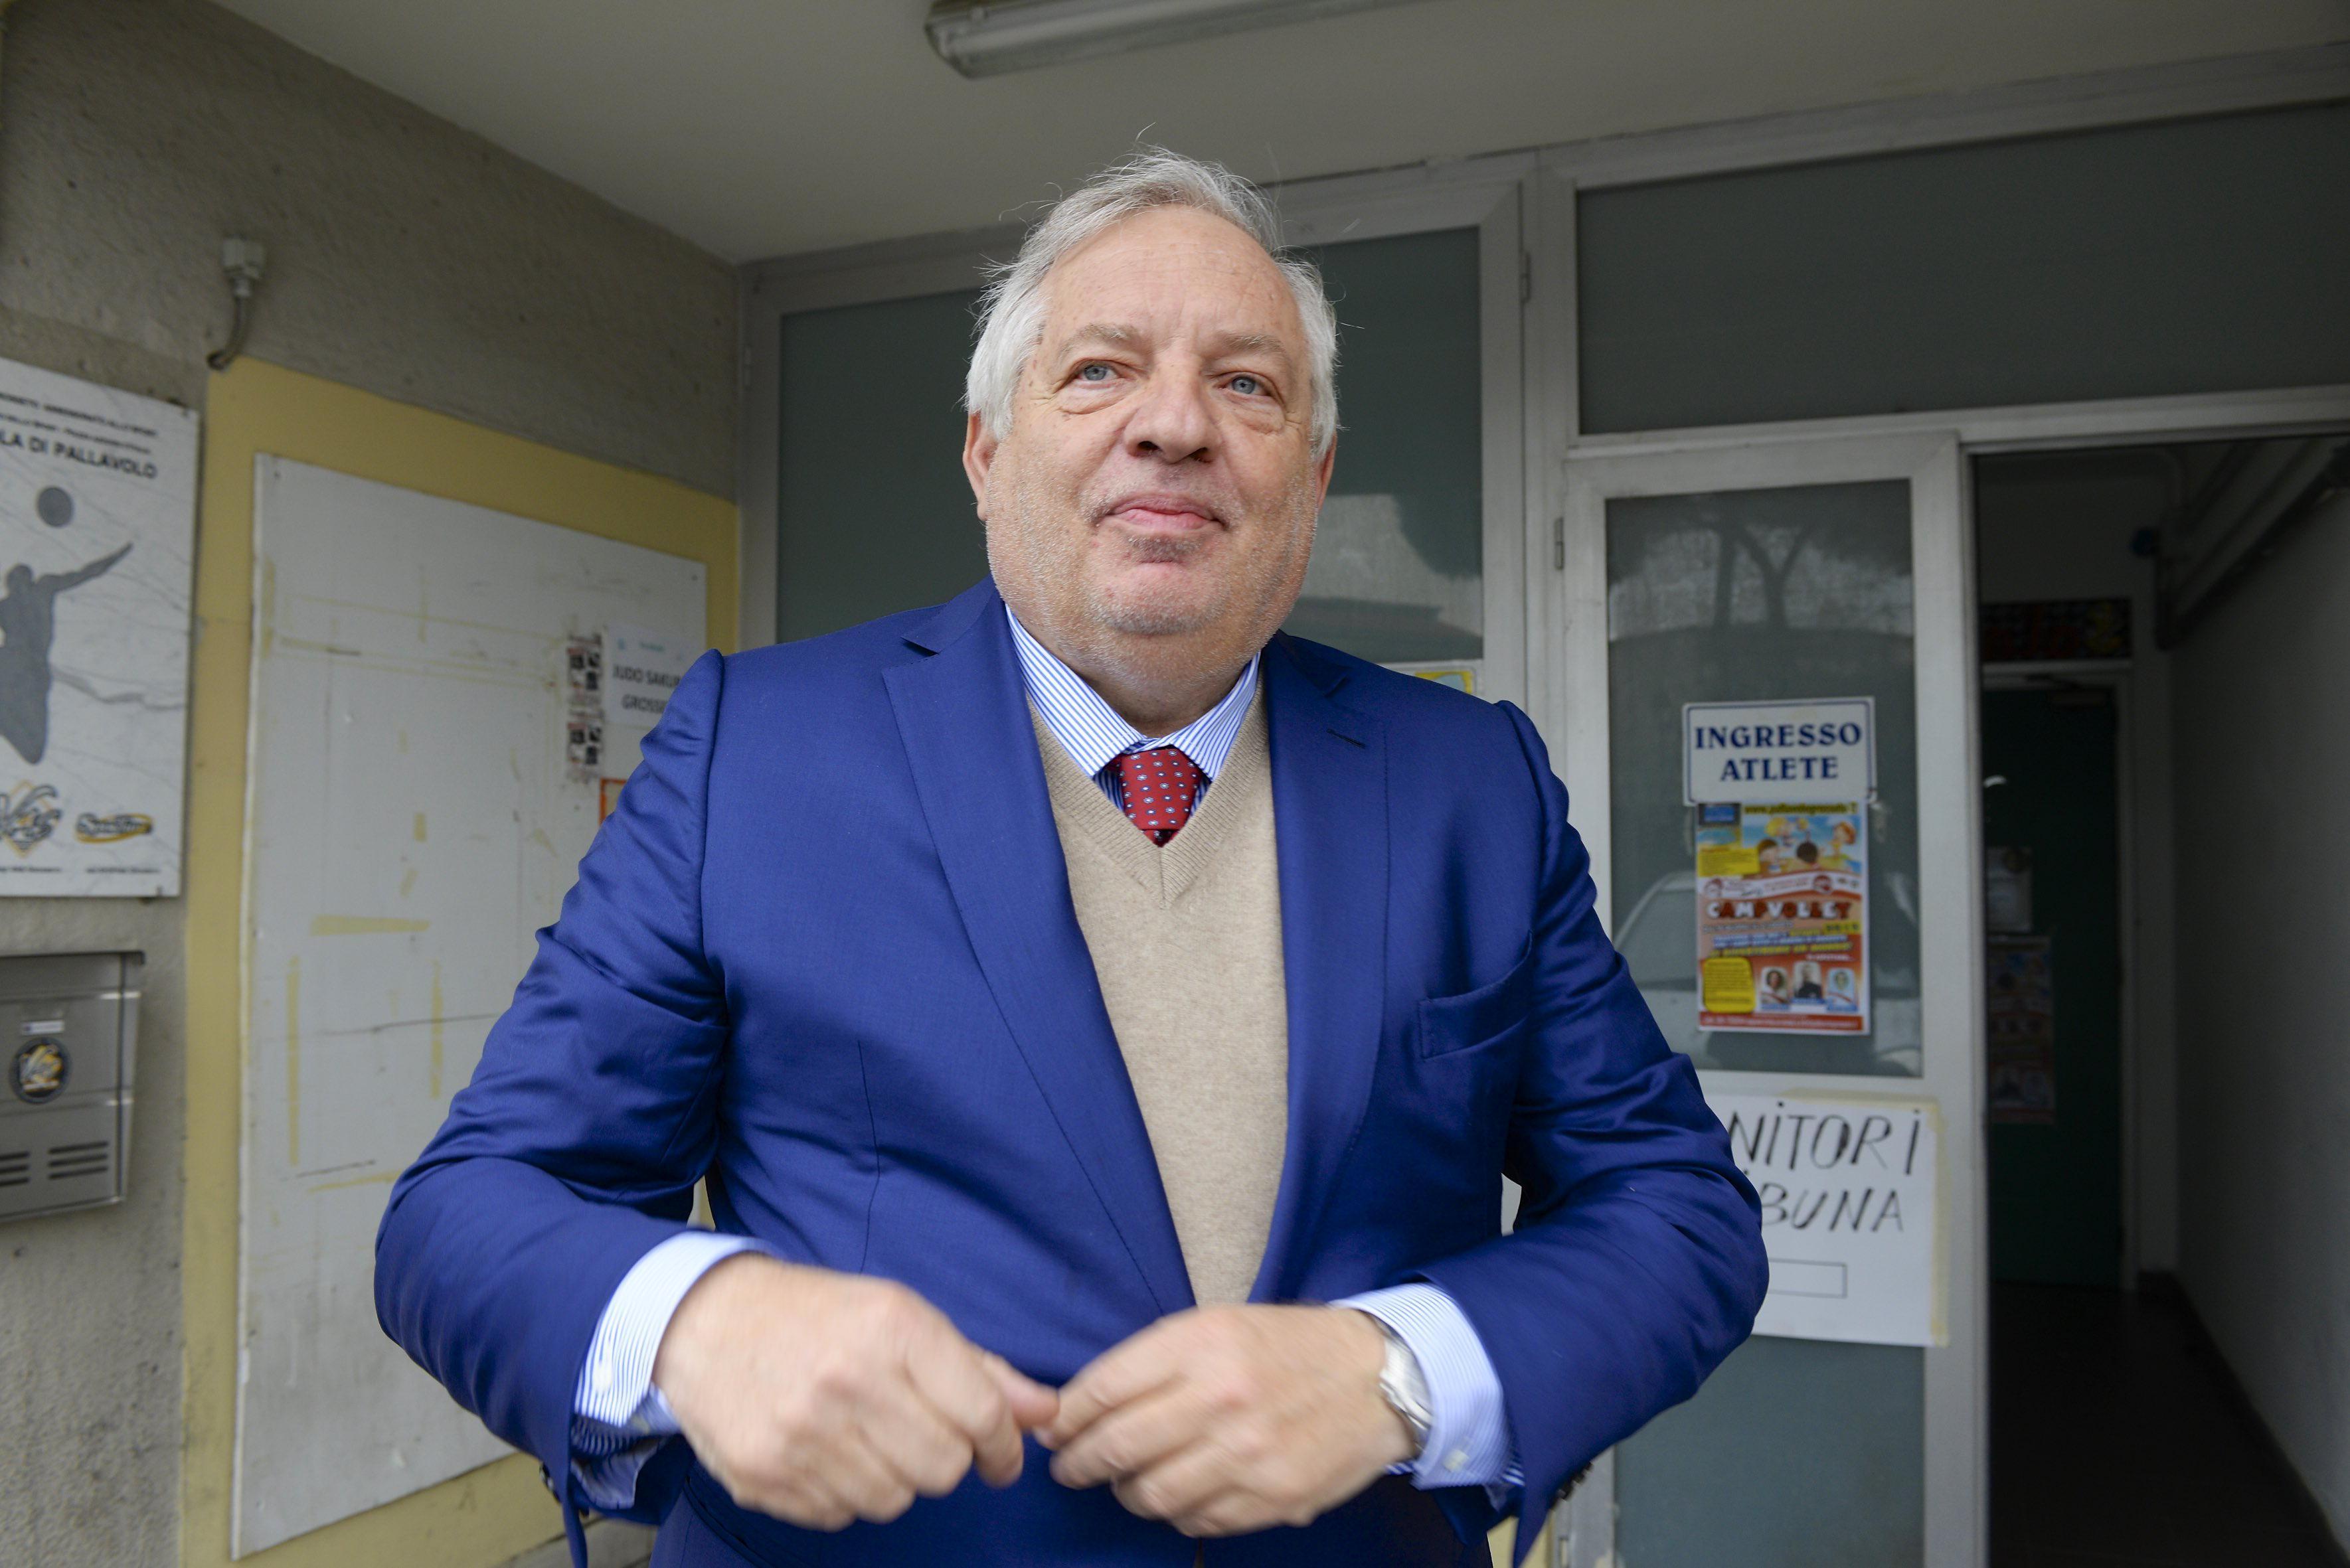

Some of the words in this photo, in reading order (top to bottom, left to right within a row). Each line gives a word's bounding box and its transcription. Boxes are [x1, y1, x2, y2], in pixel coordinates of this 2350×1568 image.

[29, 436, 47, 454] DI
[54, 441, 157, 479] PALLAVOLO
[1695, 722, 1861, 749] INGRESSO
[1721, 756, 1839, 781] ATLETE
[1743, 1167, 1904, 1233] BUNA
